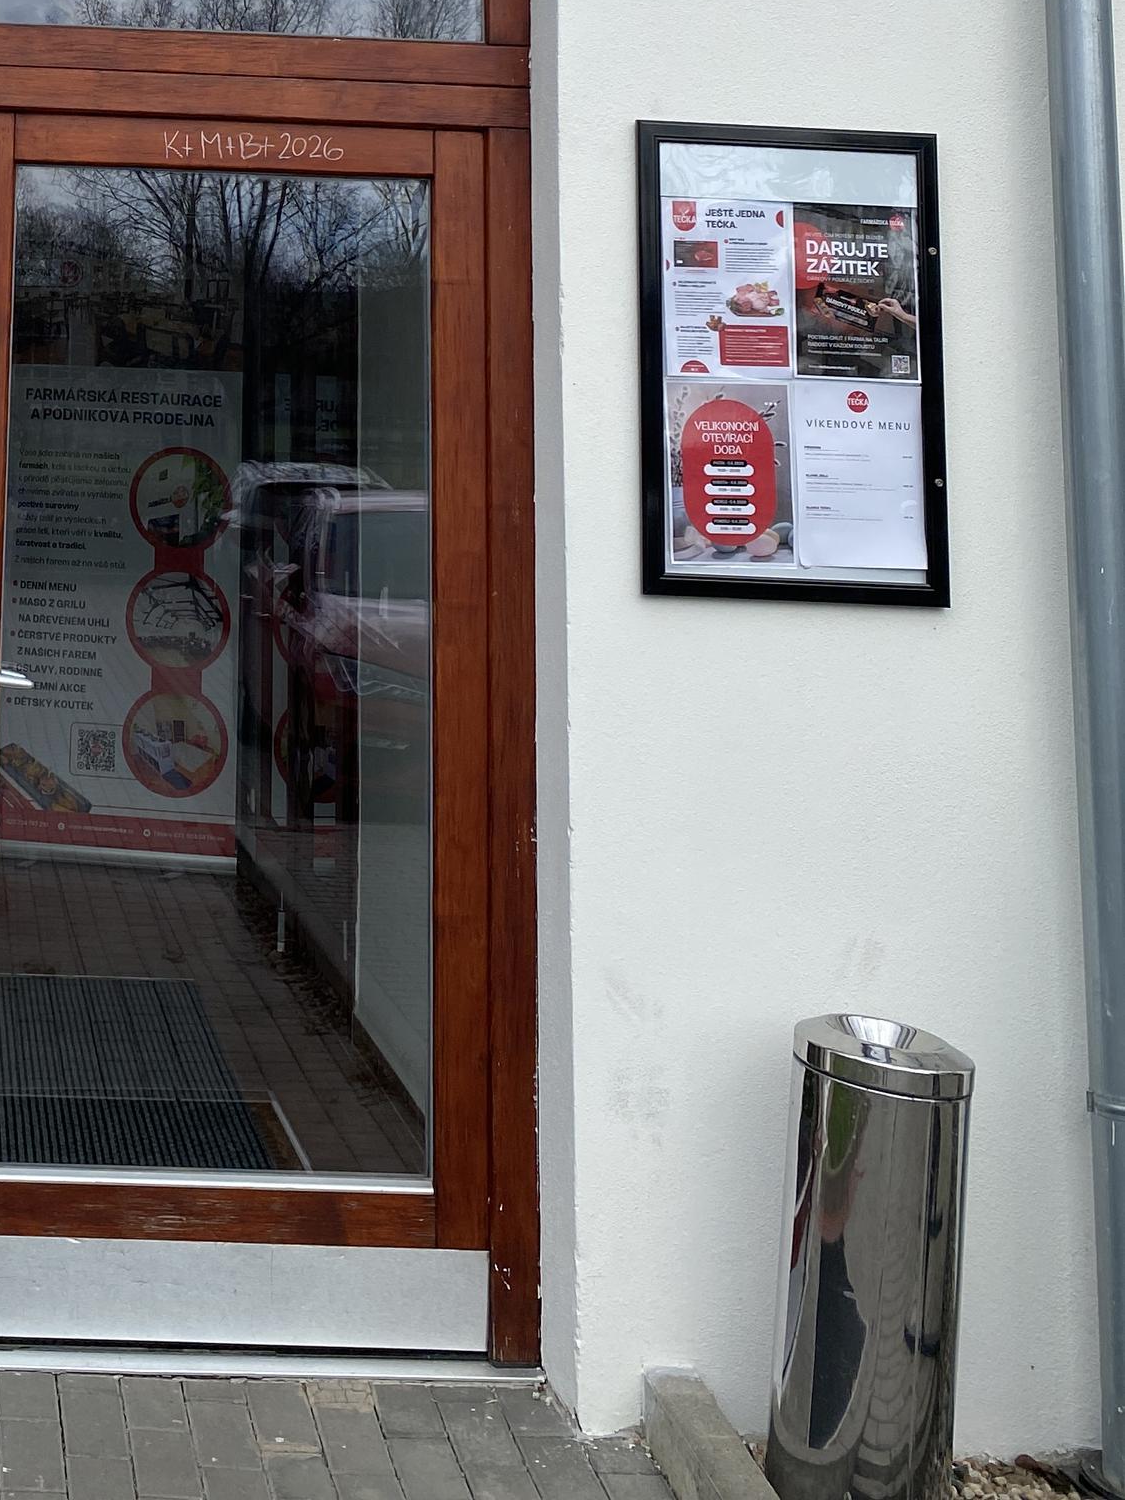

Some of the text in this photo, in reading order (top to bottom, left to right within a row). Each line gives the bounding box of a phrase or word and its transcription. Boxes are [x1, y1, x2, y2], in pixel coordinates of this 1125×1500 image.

[705, 208, 734, 218] JEŠTĚ
[735, 210, 766, 219] JEDNA
[805, 239, 889, 259] DARUJTE
[806, 256, 881, 277] ZÁŽITEK
[120, 391, 223, 408] RESTAURACE
[31, 408, 40, 420] A
[132, 411, 215, 428] PRODEJNA
[805, 417, 911, 431] VÍKENDOVÉ MENU
[694, 420, 760, 432] VELIKONOČNÍ
[702, 432, 753, 444] OTEVÍRACÍ
[713, 445, 743, 455] DOBA
[20, 579, 77, 592] DENNÍ MENU
[19, 597, 47, 607] MASO
[56, 599, 86, 610] GRILU
[18, 613, 31, 624] NA
[17, 628, 117, 645] ČERSTVÉ PRODUKTY
[62, 650, 97, 661] FAREM
[59, 666, 104, 678] RODINNÉ
[58, 682, 87, 693] AKCE
[14, 695, 94, 711] DĚTSKÝ KOUTEK
